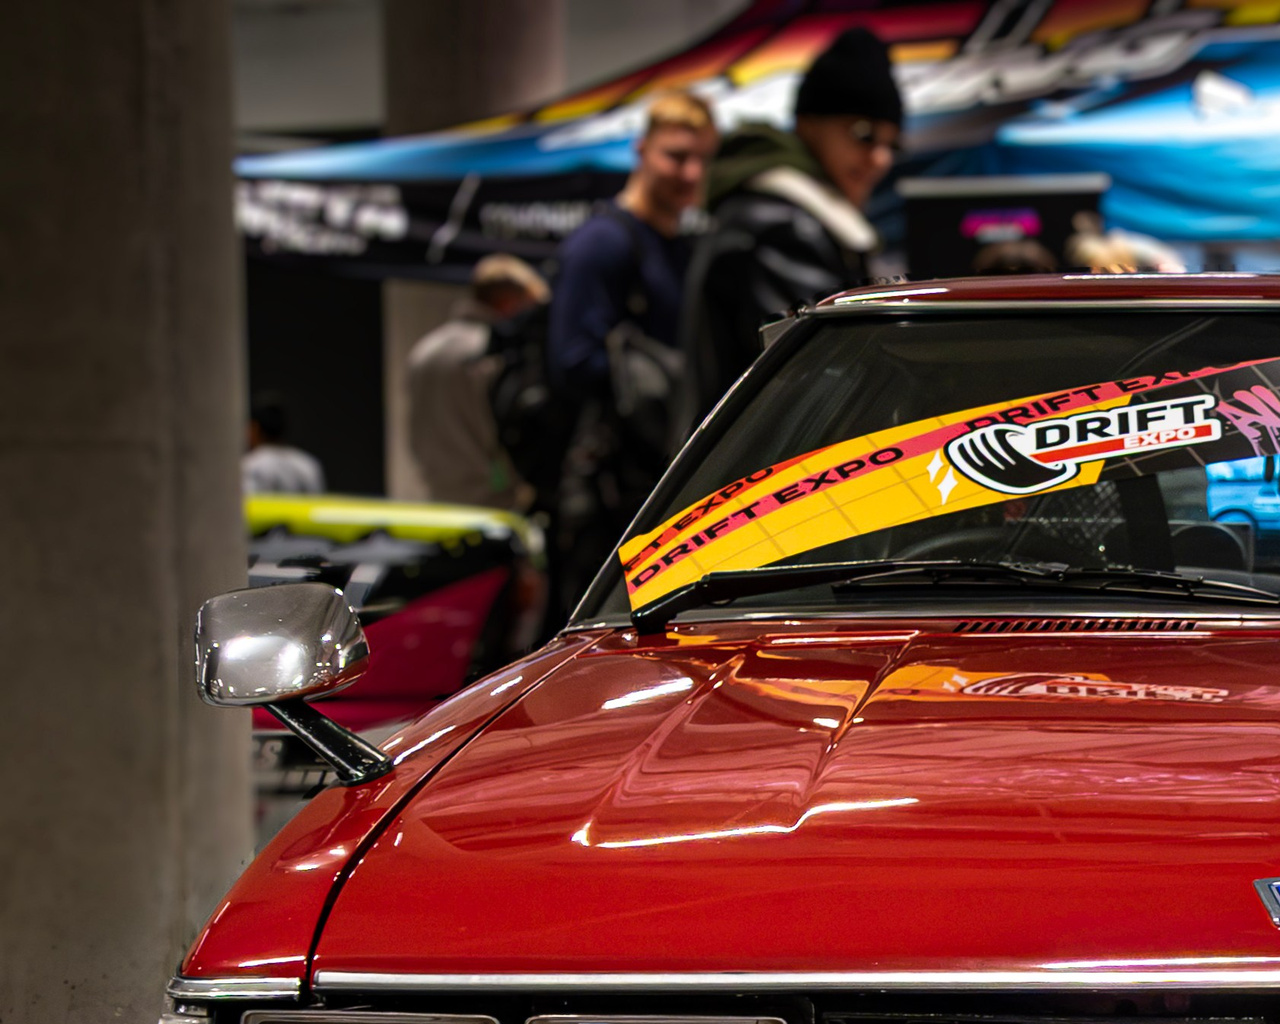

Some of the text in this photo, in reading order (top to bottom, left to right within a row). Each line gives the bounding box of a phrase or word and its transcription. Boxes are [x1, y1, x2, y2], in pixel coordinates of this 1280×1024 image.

[1035, 399, 1206, 450] DRIFT
[1123, 427, 1197, 450] EXPO
[630, 446, 904, 589] DRIFT EXPO
[674, 465, 774, 532] EXPO
